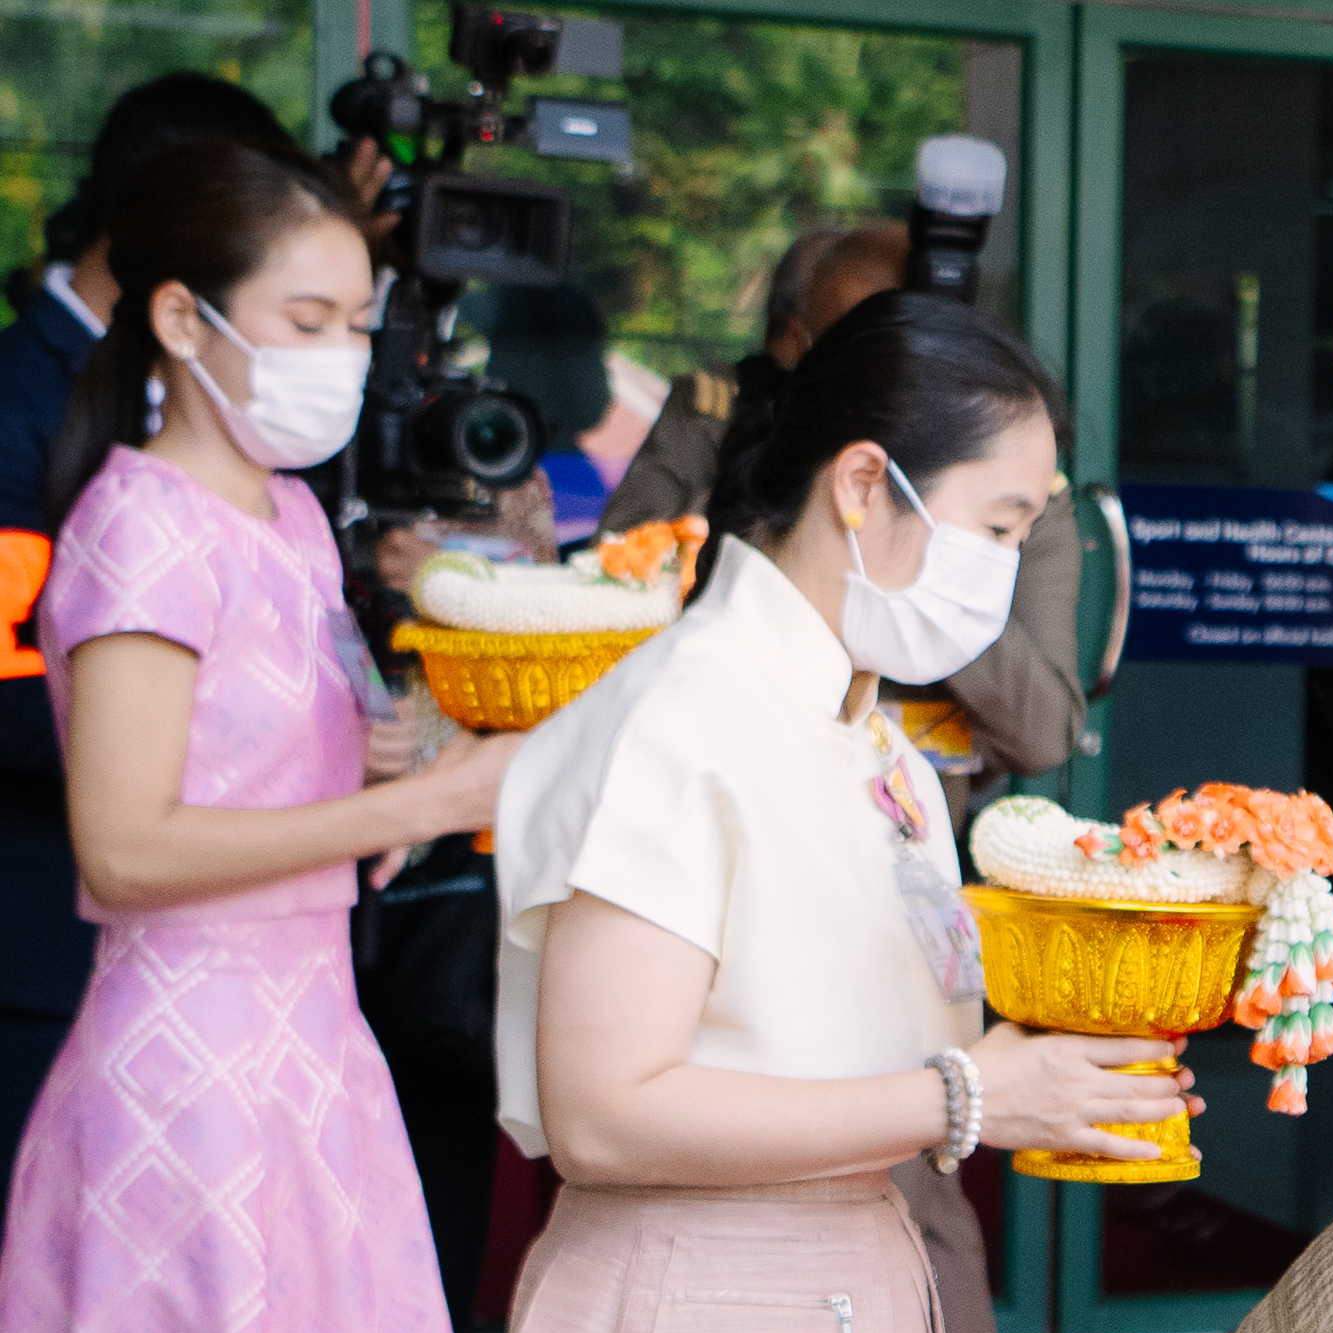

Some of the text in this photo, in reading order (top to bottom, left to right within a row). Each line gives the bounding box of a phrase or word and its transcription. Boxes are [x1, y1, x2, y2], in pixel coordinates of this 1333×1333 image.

[1132, 517, 1180, 542] Sport
[1184, 520, 1220, 541] and
[1223, 521, 1282, 542] Health
[1246, 545, 1300, 562] Hours
[1303, 546, 1322, 562] of
